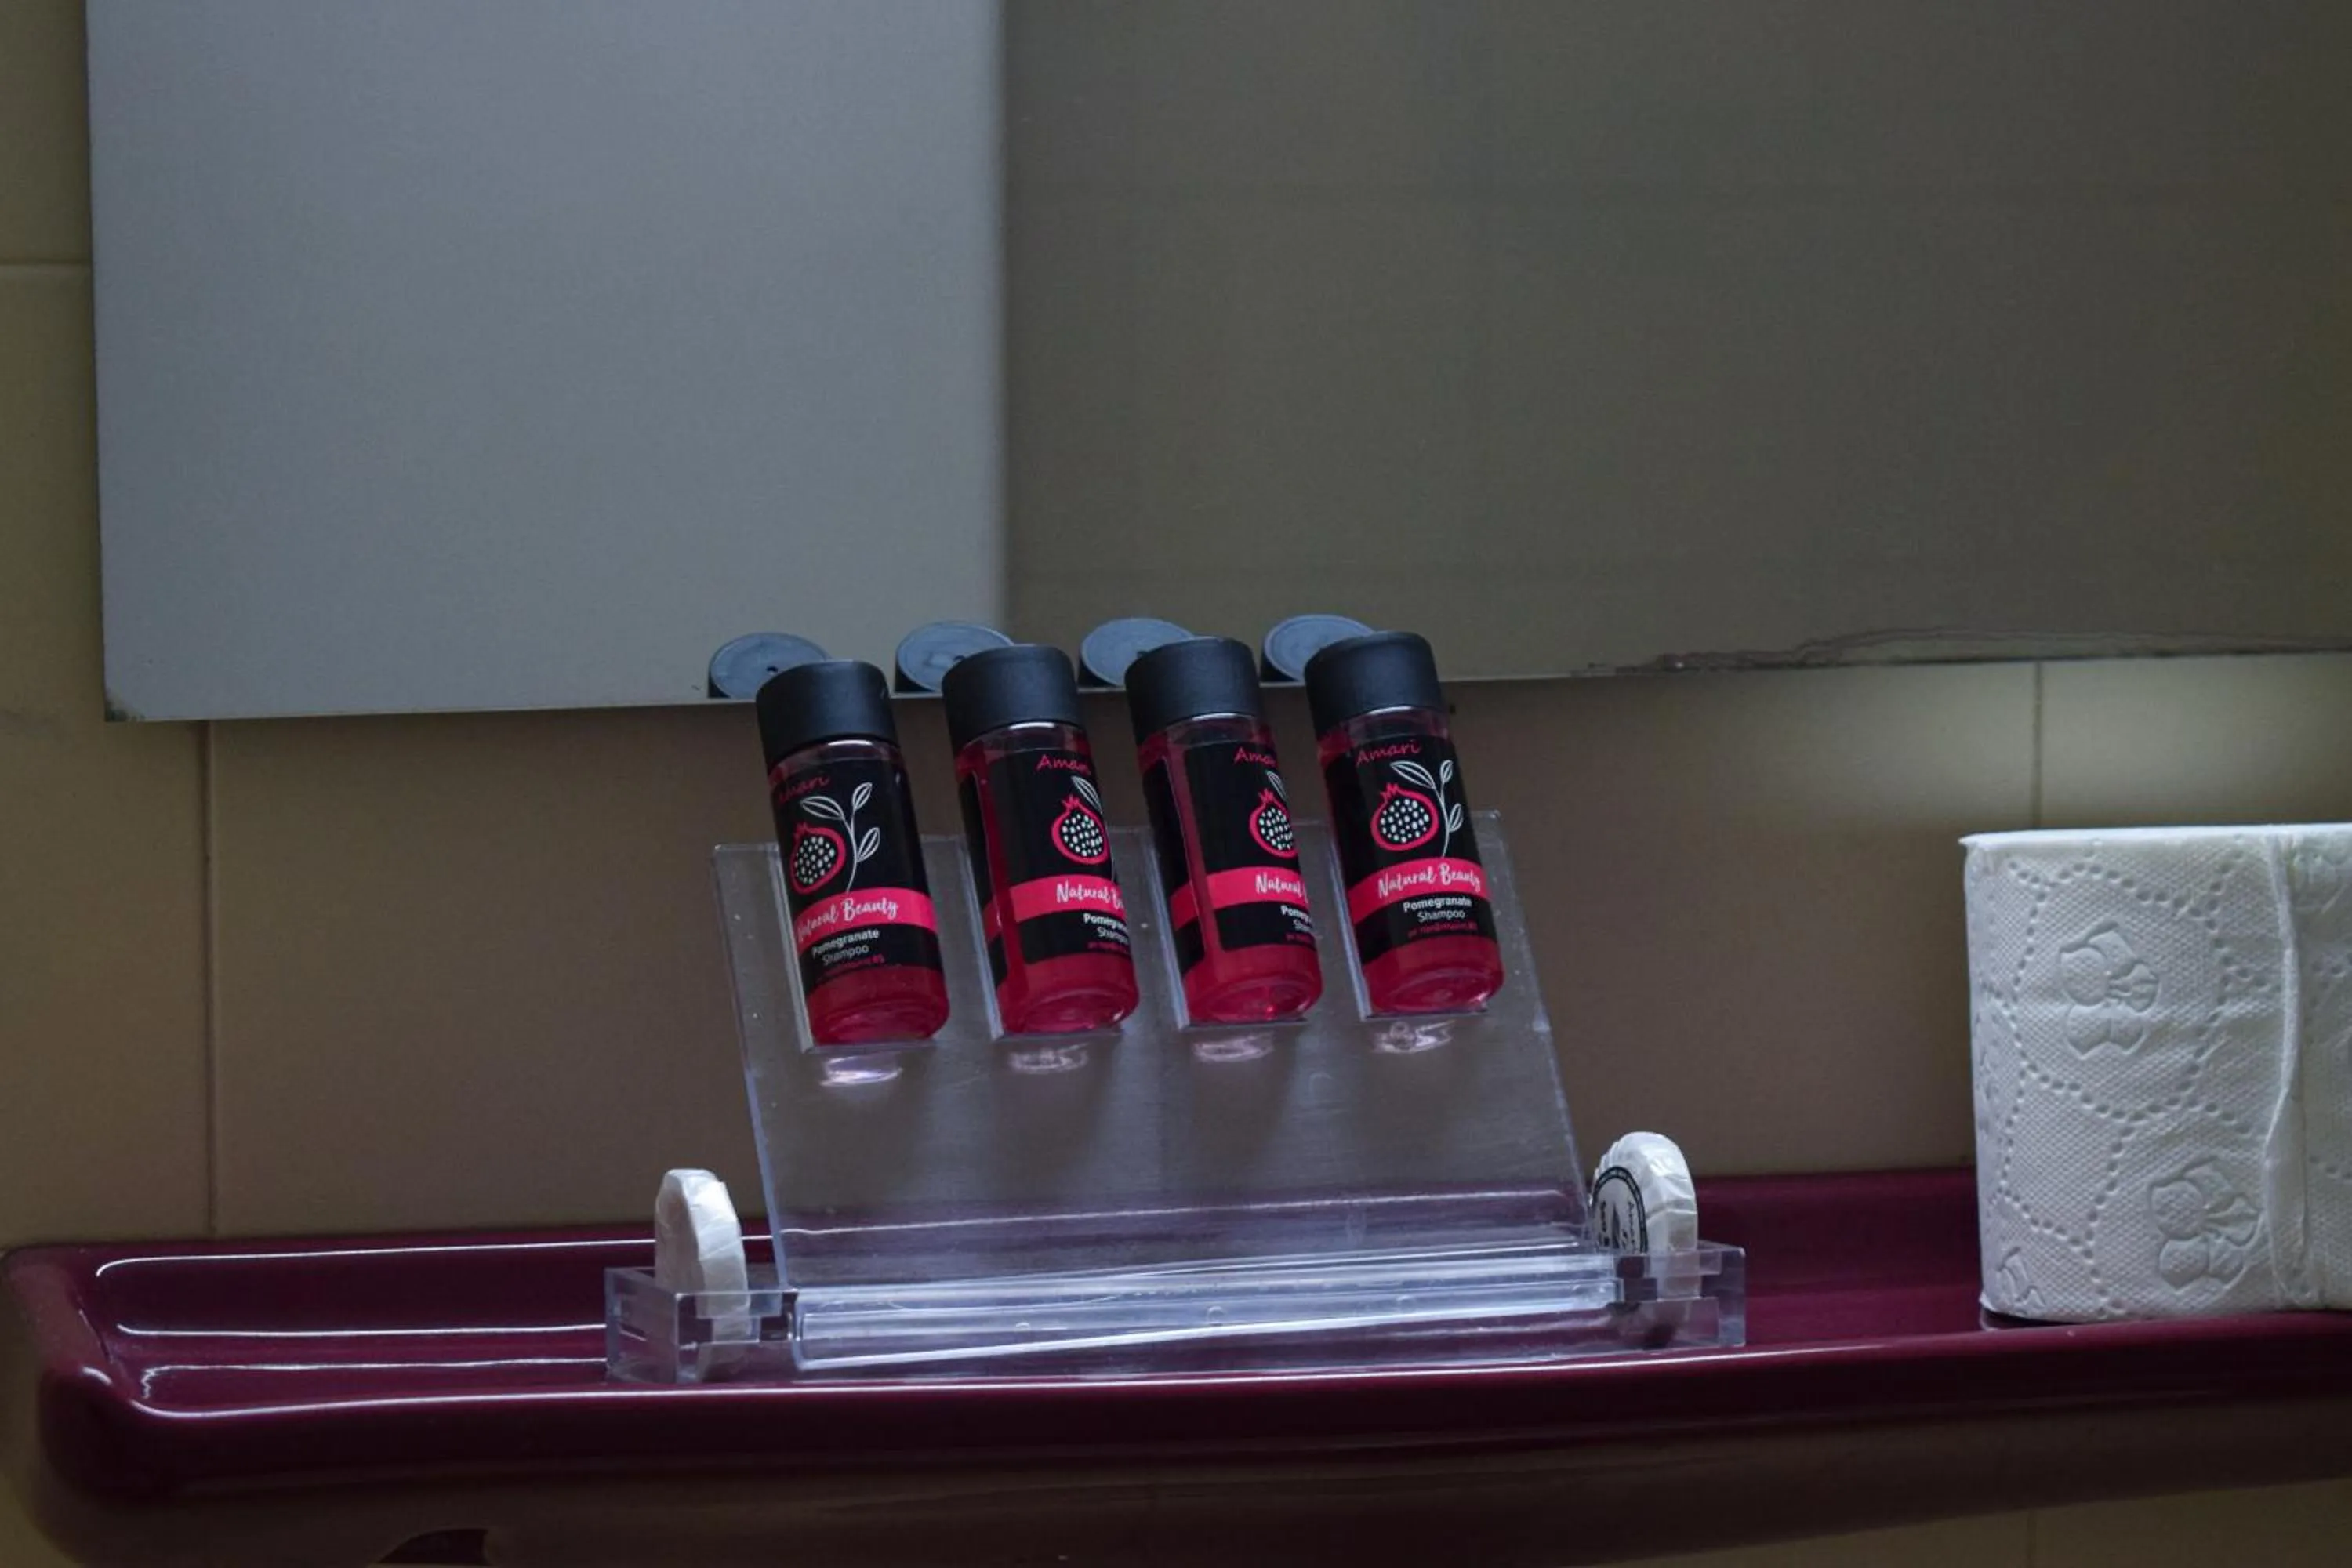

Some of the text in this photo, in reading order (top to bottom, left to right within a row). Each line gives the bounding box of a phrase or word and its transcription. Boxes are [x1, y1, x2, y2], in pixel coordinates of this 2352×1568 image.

[1356, 739, 1421, 766] Amari
[1056, 880, 1110, 904] Natural
[1255, 873, 1301, 898] Natural
[1377, 862, 1481, 899] Natural Beauty
[841, 897, 898, 922] Beauty
[1403, 897, 1472, 913] Pomegranate
[1417, 909, 1465, 924] Shampoo
